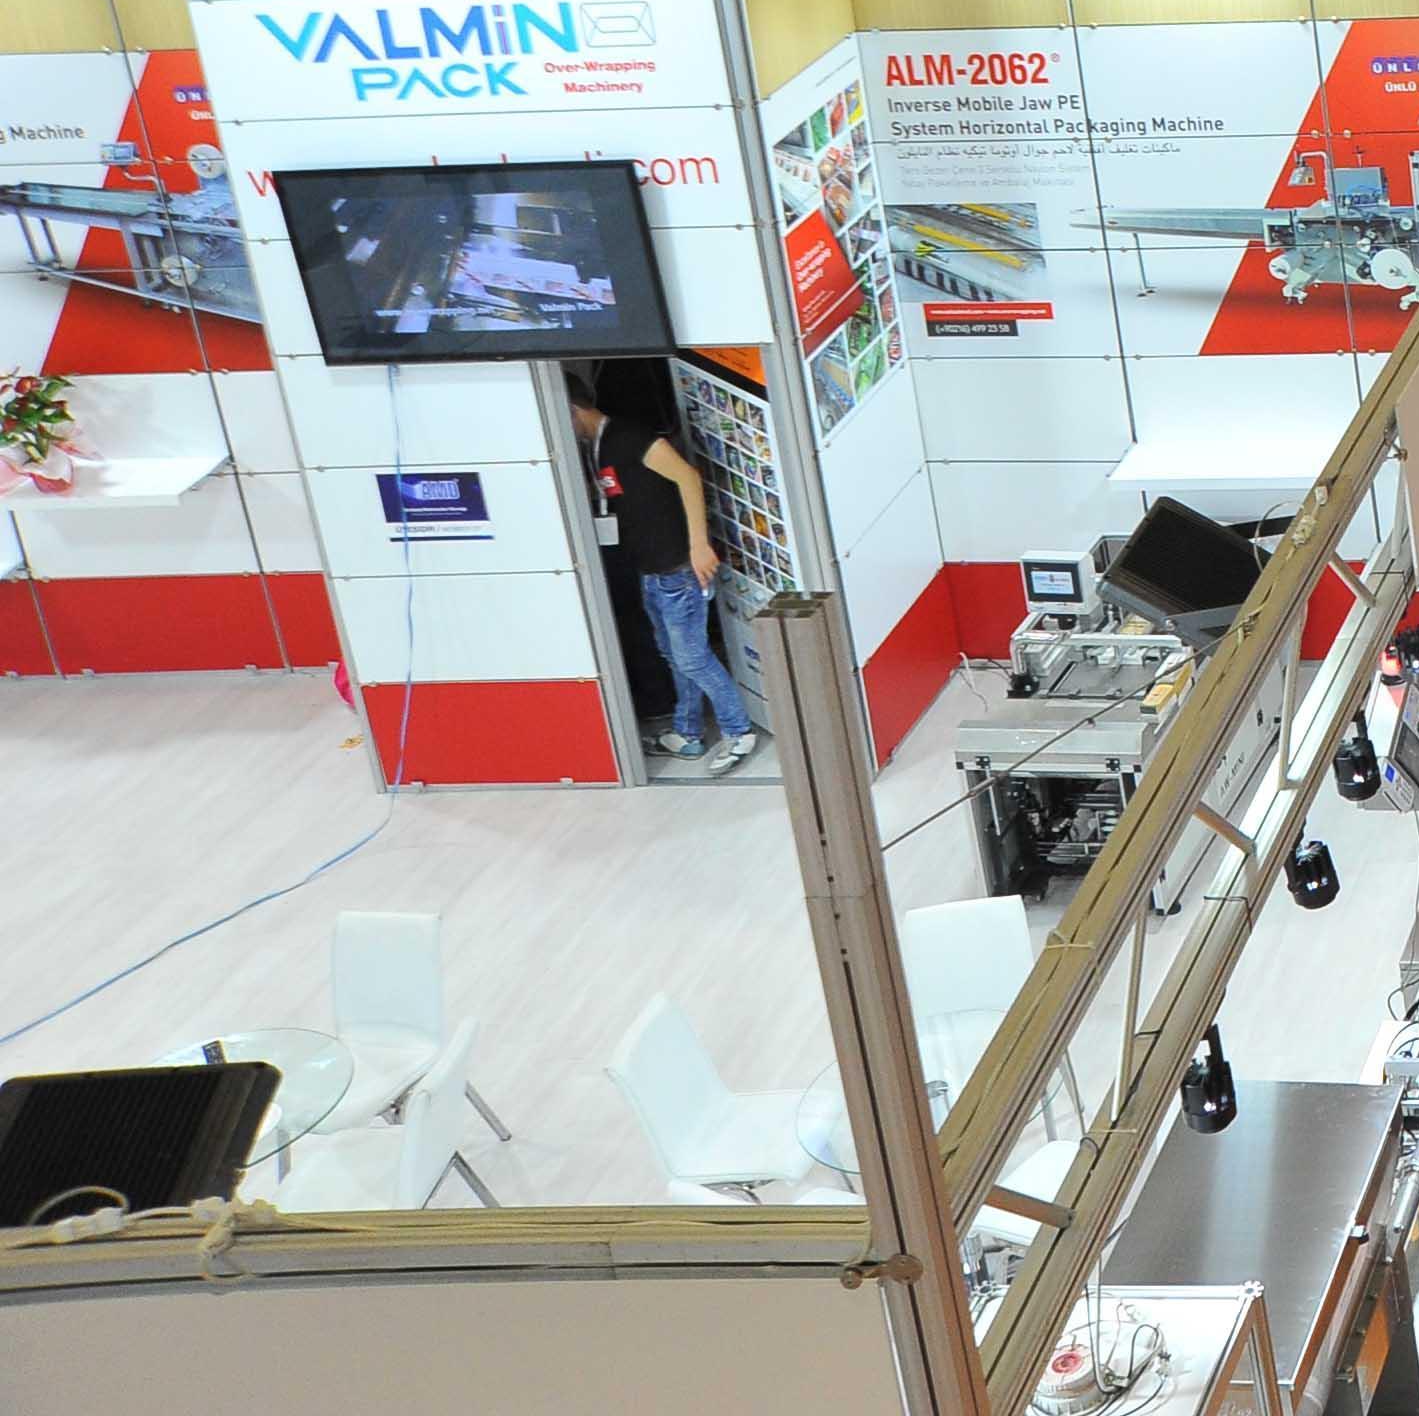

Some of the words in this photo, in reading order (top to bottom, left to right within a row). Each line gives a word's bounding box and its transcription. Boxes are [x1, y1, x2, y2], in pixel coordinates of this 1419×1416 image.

[543, 59, 656, 79] Over-Wrapping
[885, 52, 1049, 88] ALM-2062
[352, 62, 529, 102] PACK
[564, 79, 643, 96] Machinery
[888, 97, 952, 113] Inverse
[956, 96, 1015, 111] Mobile
[1020, 95, 1053, 111] Jaw
[1058, 95, 1081, 110] PE
[9, 122, 85, 142] Machine
[891, 120, 955, 138] System
[959, 118, 1049, 135] Horizontal
[1055, 117, 1148, 137] Packaging
[1152, 117, 1225, 133] Machine
